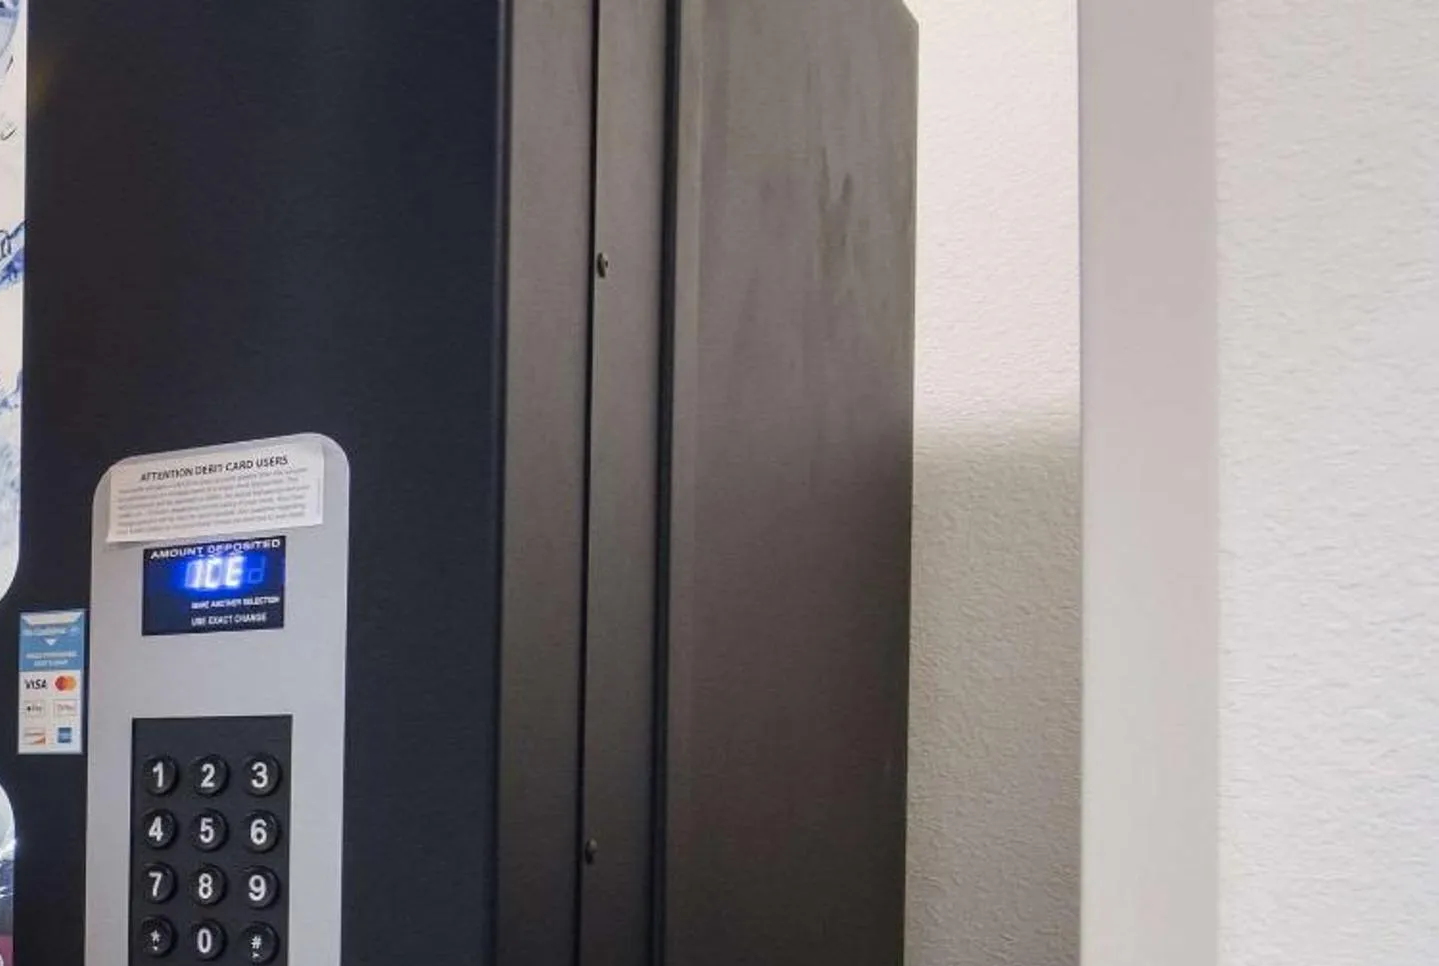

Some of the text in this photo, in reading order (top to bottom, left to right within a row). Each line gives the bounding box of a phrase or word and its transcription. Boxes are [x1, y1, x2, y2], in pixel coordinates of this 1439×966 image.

[141, 455, 289, 482] ATTENTION DEBIT CARD USERS
[150, 539, 281, 560] AMOUNT DEPOSITED
[24, 679, 47, 690] VISA
[153, 761, 164, 787] 1
[201, 763, 215, 788] 2
[251, 762, 268, 788] 3
[148, 816, 163, 841] 4
[200, 818, 214, 843] 5
[250, 819, 267, 845] 6
[148, 872, 162, 897] 7
[198, 873, 213, 899] 8
[248, 875, 266, 901] 9
[196, 928, 212, 953] 0
